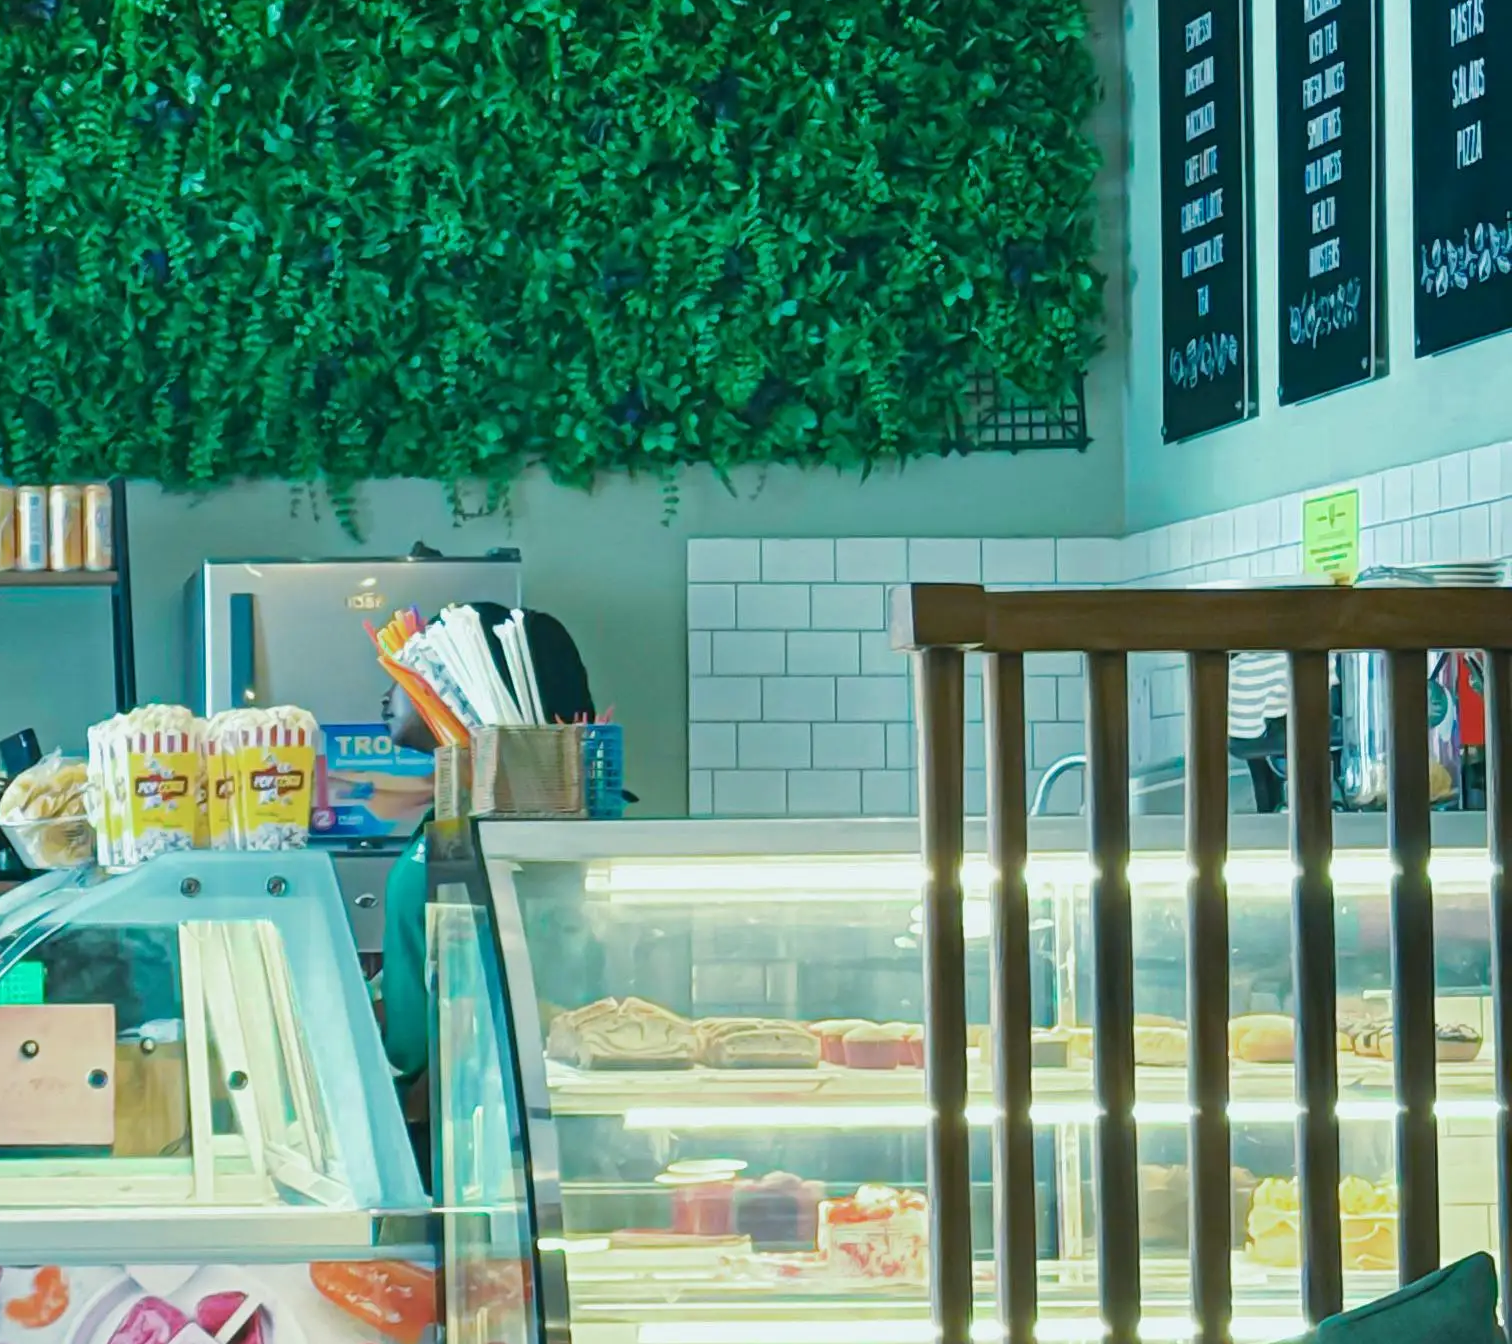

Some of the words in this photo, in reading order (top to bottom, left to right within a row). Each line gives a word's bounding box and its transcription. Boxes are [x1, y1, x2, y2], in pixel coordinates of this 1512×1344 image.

[1452, 57, 1485, 109] SALADS
[1456, 120, 1483, 170] PIZZA
[335, 735, 401, 755] TRO
